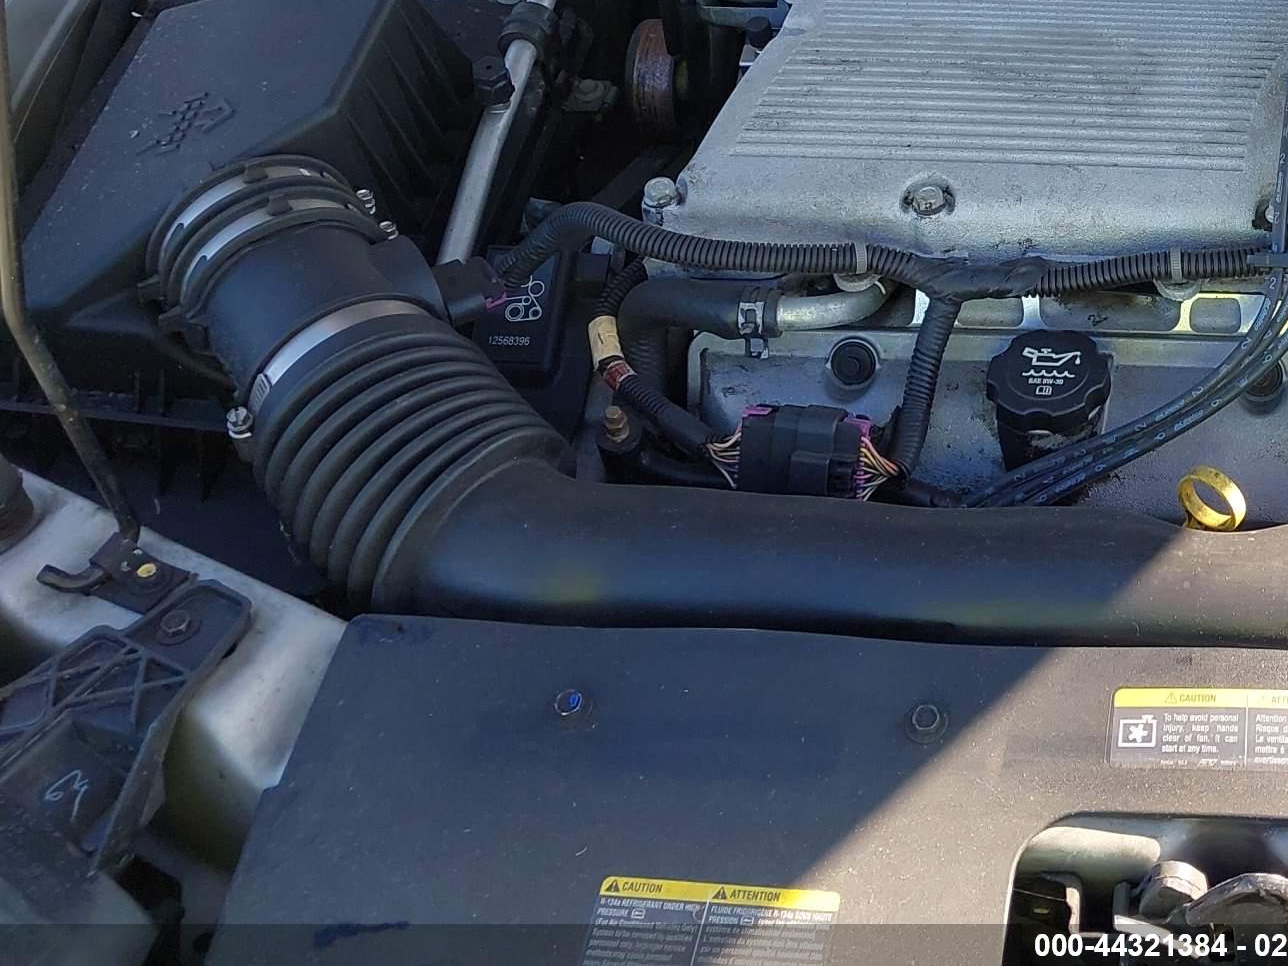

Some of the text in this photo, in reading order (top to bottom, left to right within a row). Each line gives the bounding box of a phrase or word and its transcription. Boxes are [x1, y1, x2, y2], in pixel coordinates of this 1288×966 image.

[488, 335, 531, 346] 12568396
[1028, 377, 1042, 385] SAE
[1179, 694, 1216, 703] CAUTION
[1164, 713, 1239, 724] To help avoid personal
[1255, 713, 1287, 723] Attention
[1191, 724, 1210, 734] keep
[1216, 724, 1239, 733] hands
[1255, 723, 1280, 734] Risque
[1162, 733, 1238, 744] clear of fan. It can
[1255, 734, 1264, 743] Le
[1161, 744, 1219, 755] start at any time.
[621, 881, 664, 894] CAUTION
[729, 889, 782, 902] ATTENTION
[596, 907, 630, 917] PRESSURE
[708, 914, 739, 925] PRESSION
